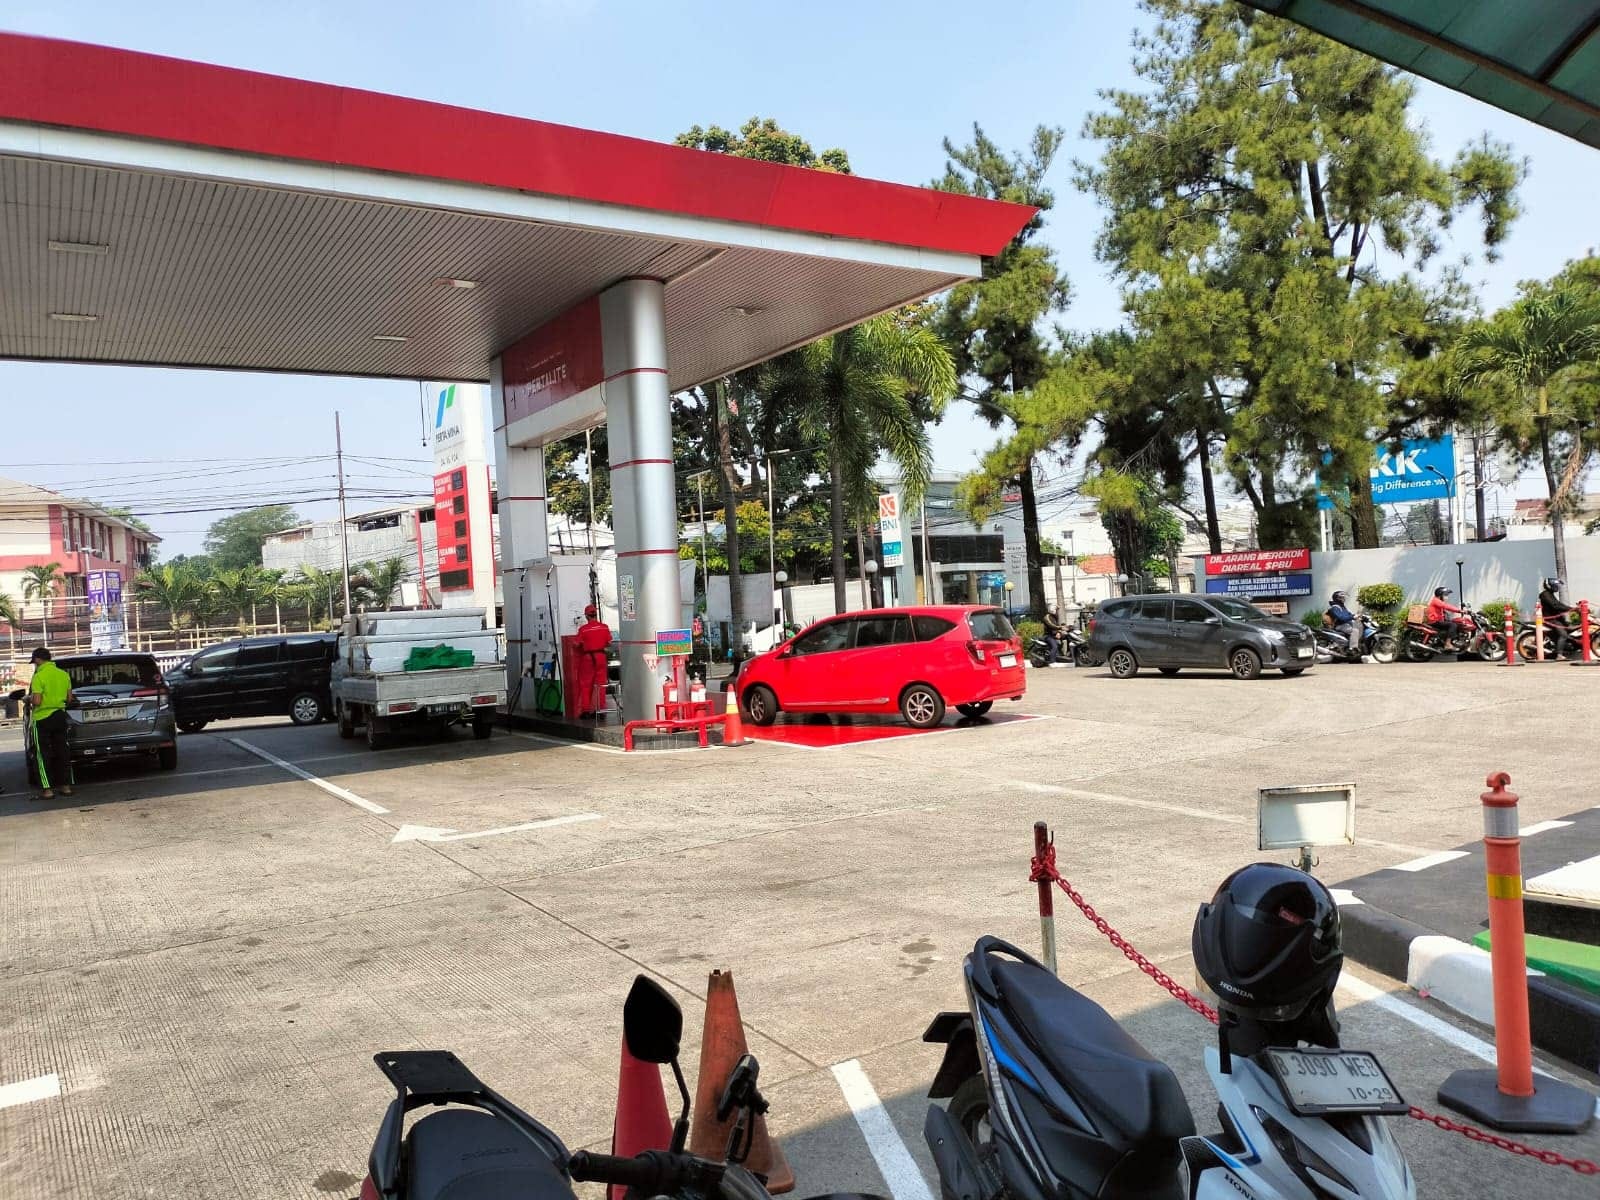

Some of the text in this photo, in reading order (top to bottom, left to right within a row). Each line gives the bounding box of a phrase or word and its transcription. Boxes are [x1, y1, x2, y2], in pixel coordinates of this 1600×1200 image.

[527, 363, 567, 396] PERTALITE
[882, 519, 897, 530] BNI
[1210, 549, 1304, 563] DILARANG MEROKOK
[1222, 561, 1292, 572] DIAREAL SPBU
[1220, 981, 1254, 999] HONDA
[1273, 1055, 1289, 1076] B
[1292, 1056, 1338, 1076] 3090
